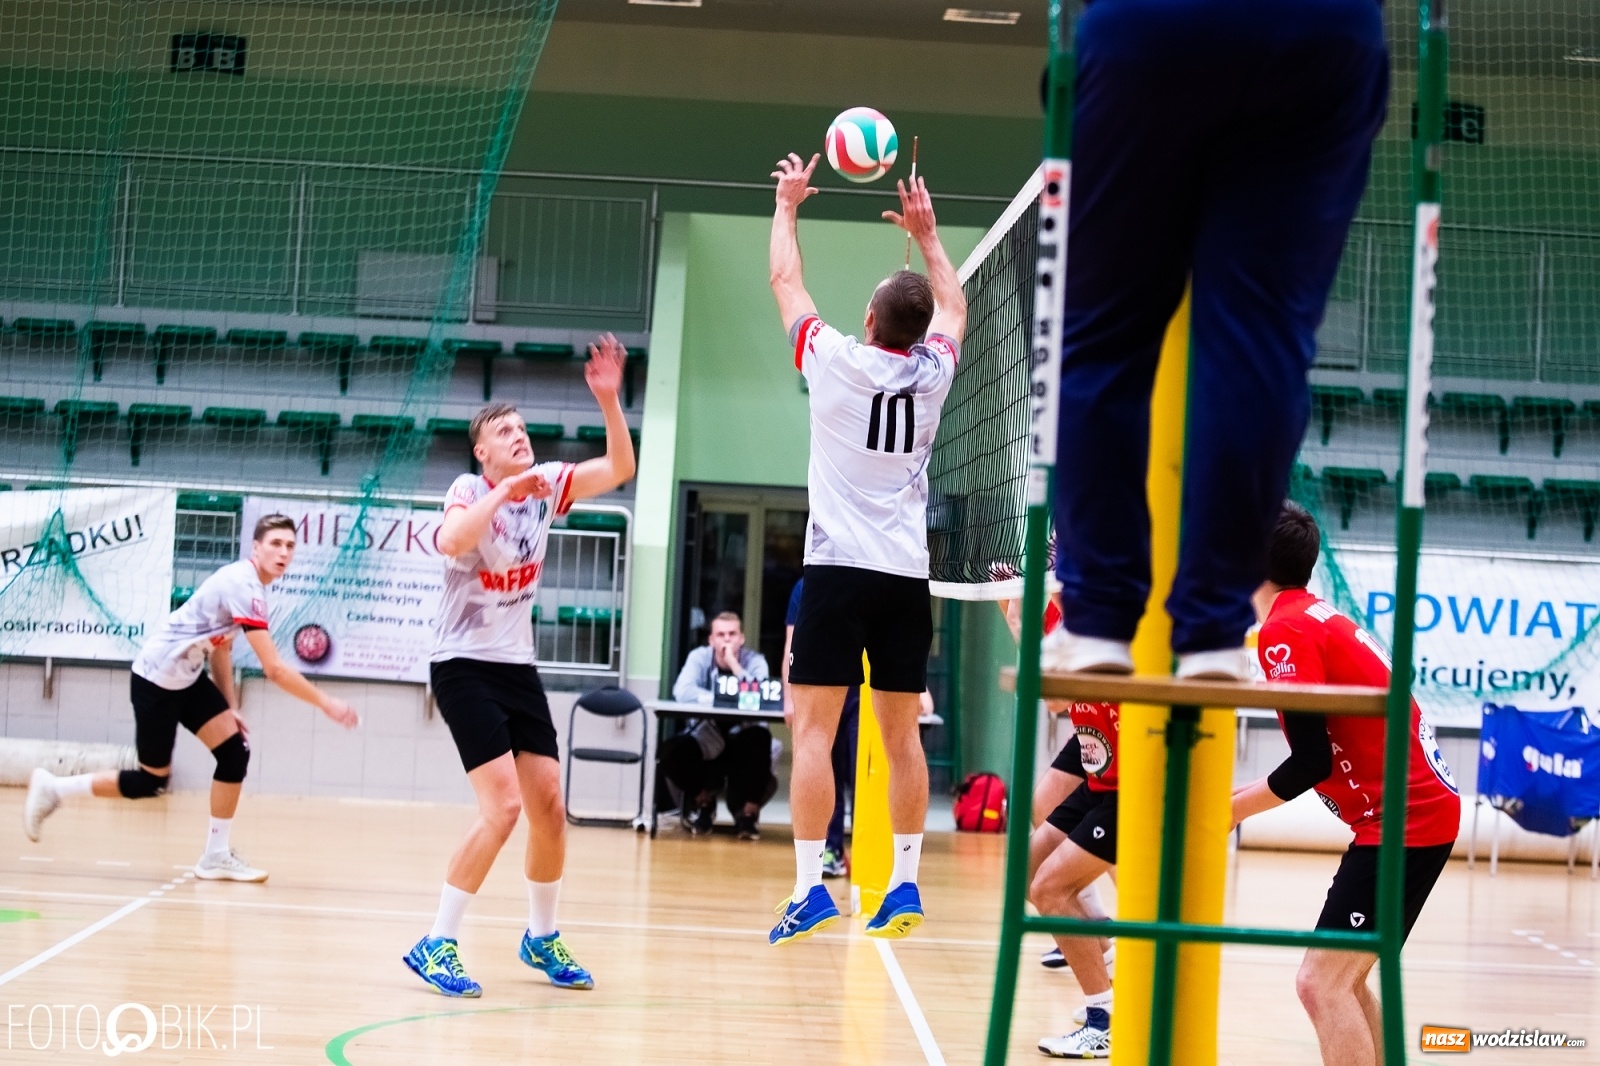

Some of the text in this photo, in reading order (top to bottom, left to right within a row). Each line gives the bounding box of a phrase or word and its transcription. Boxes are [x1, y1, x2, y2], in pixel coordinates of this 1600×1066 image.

[213, 48, 235, 68] B
[866, 391, 915, 453] 10
[342, 590, 423, 606] produkcyjny
[347, 611, 405, 626] Czekamy
[408, 618, 424, 626] na
[1366, 591, 1597, 644] POWIAT
[760, 679, 782, 702] 12
